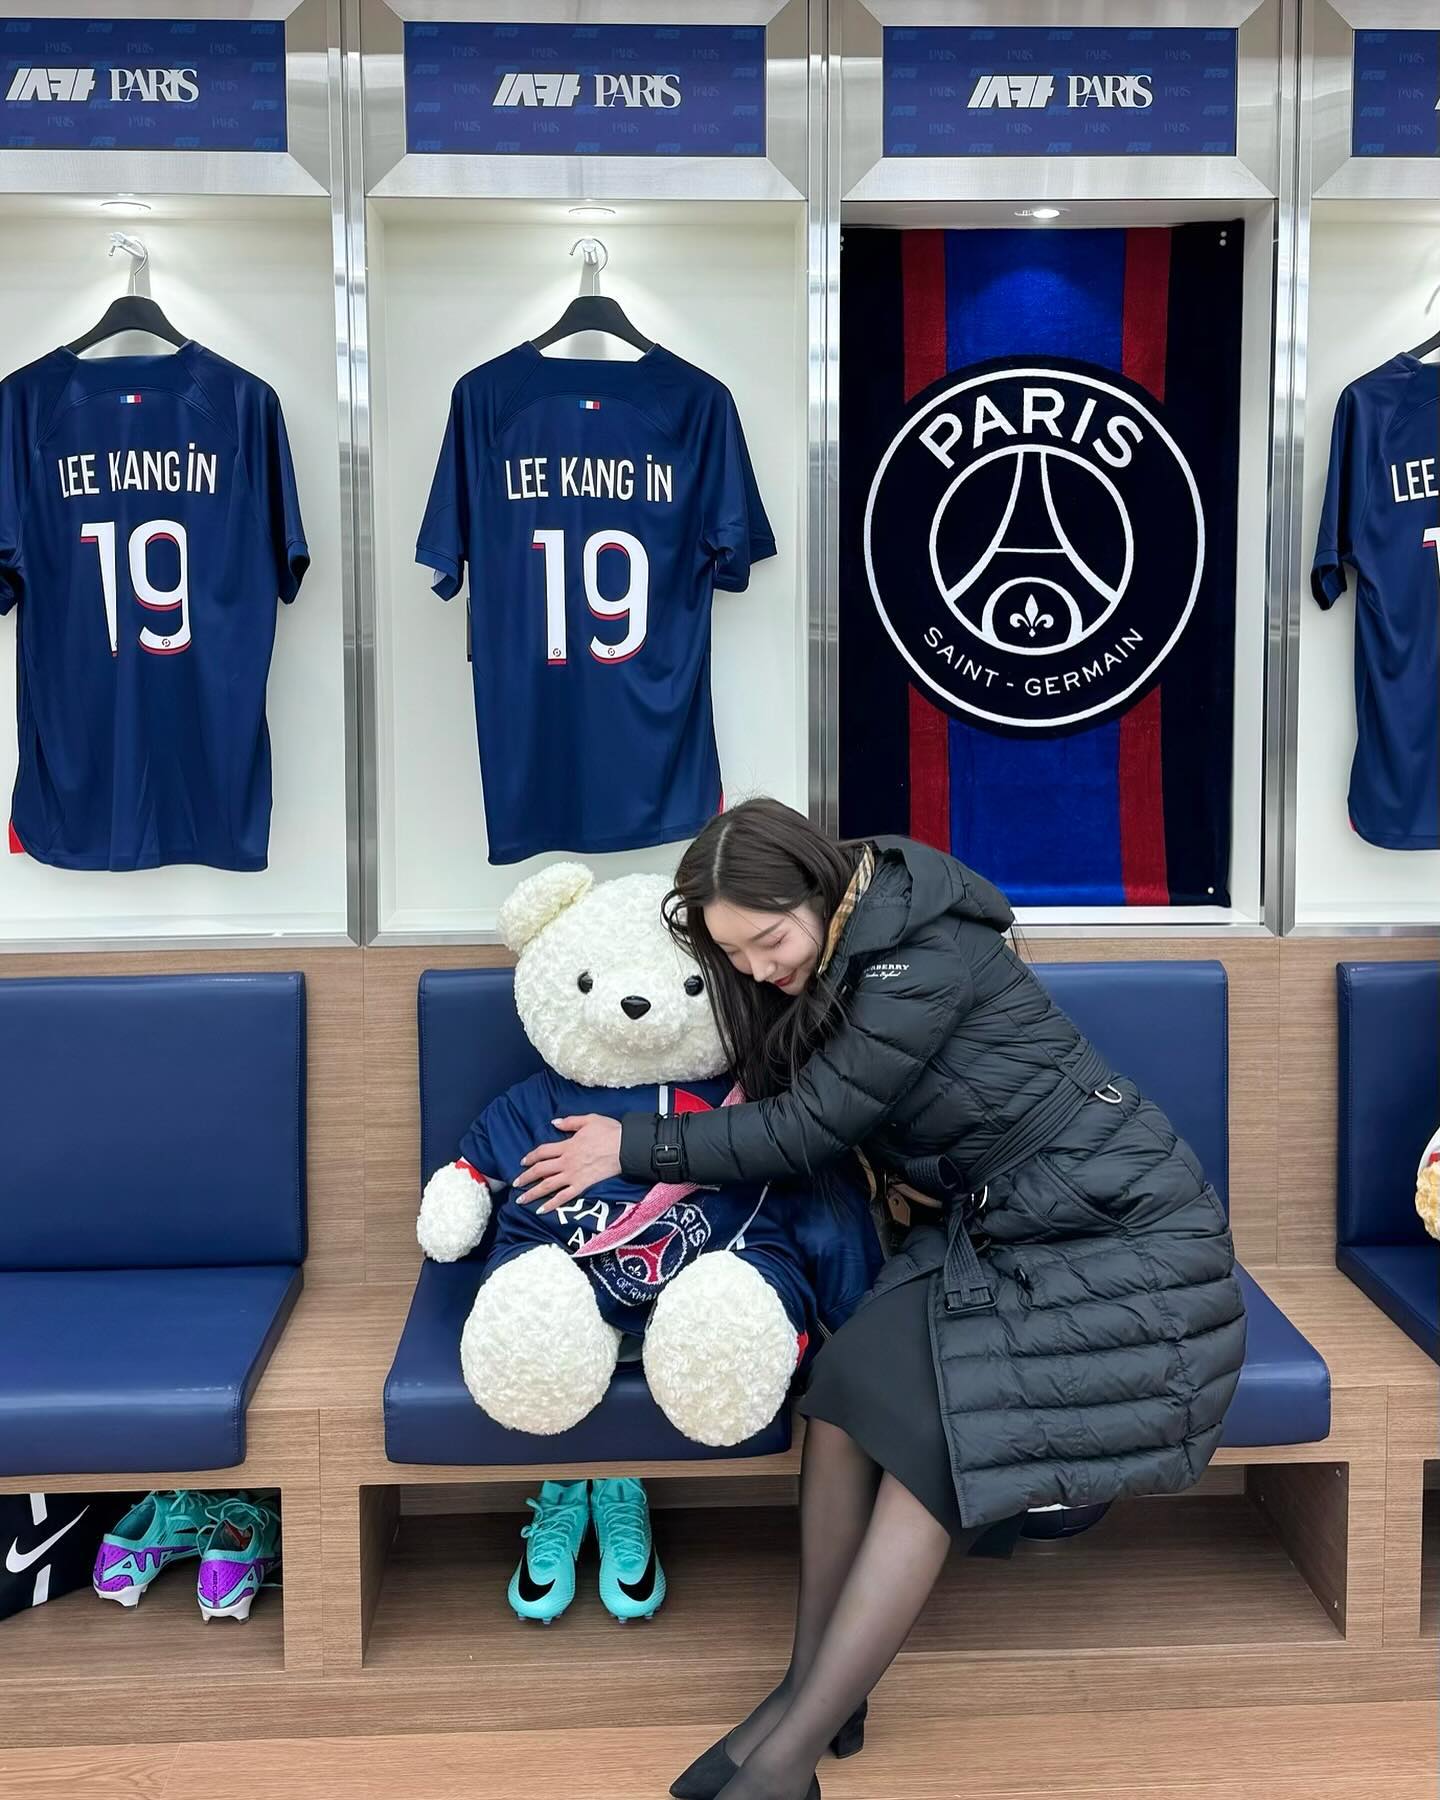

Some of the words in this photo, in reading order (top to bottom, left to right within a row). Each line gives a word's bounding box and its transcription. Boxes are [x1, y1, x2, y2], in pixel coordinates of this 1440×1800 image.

[108, 68, 199, 102] PARIS
[594, 74, 681, 108] PARIS
[1067, 75, 1153, 109] PARIS
[919, 387, 1144, 469] PARIS
[58, 454, 100, 499] LEE
[108, 450, 180, 492] KANG
[505, 457, 549, 500] LEE
[560, 456, 635, 500] KANG
[1391, 457, 1439, 502] LEE
[80, 519, 192, 657] 19
[532, 529, 649, 665] 19
[663, 1206, 707, 1248] ARIS
